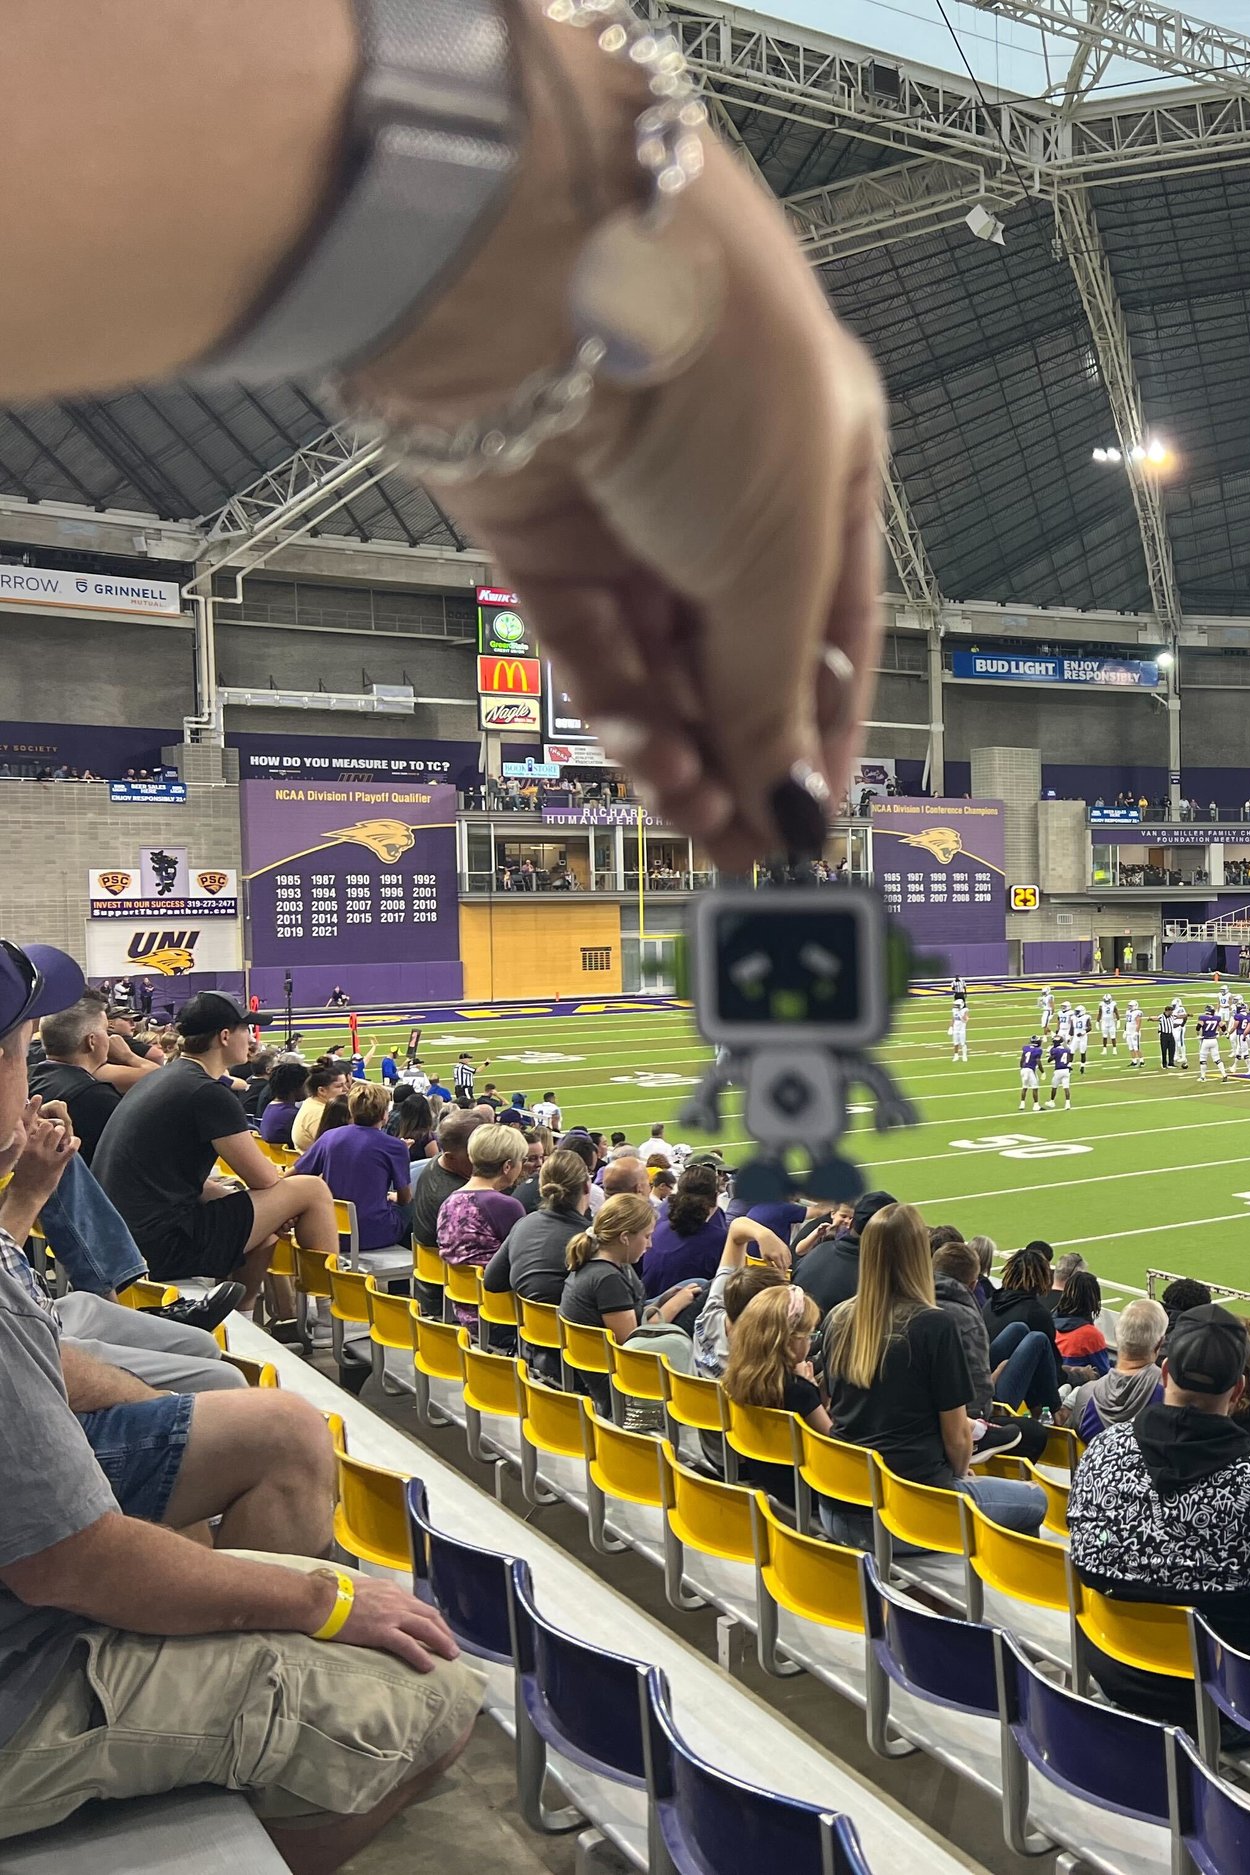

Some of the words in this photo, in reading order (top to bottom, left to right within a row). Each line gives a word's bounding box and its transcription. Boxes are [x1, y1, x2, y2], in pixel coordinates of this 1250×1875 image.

[94, 584, 166, 600] GRINNELL
[130, 599, 164, 608] MUTUAL
[975, 659, 1008, 673] BUD
[1010, 661, 1055, 676] LIGHT
[1064, 661, 1099, 671] ENJOY
[1064, 670, 1142, 682] RESPONSIBLY
[486, 703, 530, 723] Nagle
[14, 744, 58, 752] SOCIETY
[250, 755, 280, 767] HOW
[283, 757, 301, 767] DO
[303, 757, 329, 768] YOU
[332, 758, 389, 770] MEASURE
[391, 760, 407, 770] UP
[409, 760, 424, 771] TO
[505, 764, 526, 772] BOOK
[534, 765, 557, 773] STORE
[275, 790, 304, 801] NCAA
[307, 790, 347, 802] Division
[355, 791, 389, 804] Playoff
[391, 792, 432, 804] Qualifier
[583, 808, 648, 818] RICHARD
[872, 804, 891, 813] NCAA
[893, 805, 920, 814] Division
[925, 806, 962, 815] Conference
[964, 806, 998, 816] Champions
[547, 815, 598, 825] HUMAN
[102, 876, 129, 886] PSC
[200, 876, 226, 886] PSC
[275, 875, 300, 885] 1985
[311, 875, 336, 885] 1987
[345, 875, 370, 885] 1990
[380, 875, 402, 885] 1991
[413, 875, 436, 885] 1992
[884, 873, 901, 881] 1985
[907, 873, 923, 881] 1987
[930, 873, 947, 881] 1990
[952, 873, 968, 881] 1991
[974, 873, 991, 881] 1992
[884, 883, 901, 892] 1993
[907, 883, 924, 892] 1994
[930, 883, 947, 892] 1995
[952, 883, 969, 892] 1996
[974, 883, 991, 892] 2001
[276, 888, 301, 898] 1993
[311, 888, 336, 898] 1994
[346, 888, 370, 898] 1995
[380, 888, 404, 897] 1996
[413, 888, 436, 897] 2001
[1014, 888, 1037, 907] 25
[907, 894, 925, 903] 2005
[930, 894, 947, 903] 2007
[952, 894, 970, 903] 2008
[974, 894, 991, 903] 2010
[93, 901, 121, 909] INVEST
[151, 900, 185, 908] SUCCESS
[276, 900, 303, 911] 2003
[311, 900, 338, 911] 2005
[346, 900, 372, 911] 2007
[380, 899, 406, 910] 2008
[413, 899, 437, 910] 2010
[886, 904, 901, 913] 011
[93, 908, 235, 917] SupportThePanthers.com
[276, 913, 302, 924] 2011
[311, 913, 338, 924] 2014
[346, 913, 372, 924] 2015
[380, 912, 405, 923] 2017
[413, 912, 437, 923] 2018
[277, 927, 304, 937] 2019
[312, 927, 338, 937] 2021
[127, 931, 200, 958] UNI
[1205, 1020, 1218, 1031] 77
[1024, 1052, 1031, 1063] 1
[1061, 1052, 1068, 1064] 4
[948, 1133, 1094, 1159] 50
